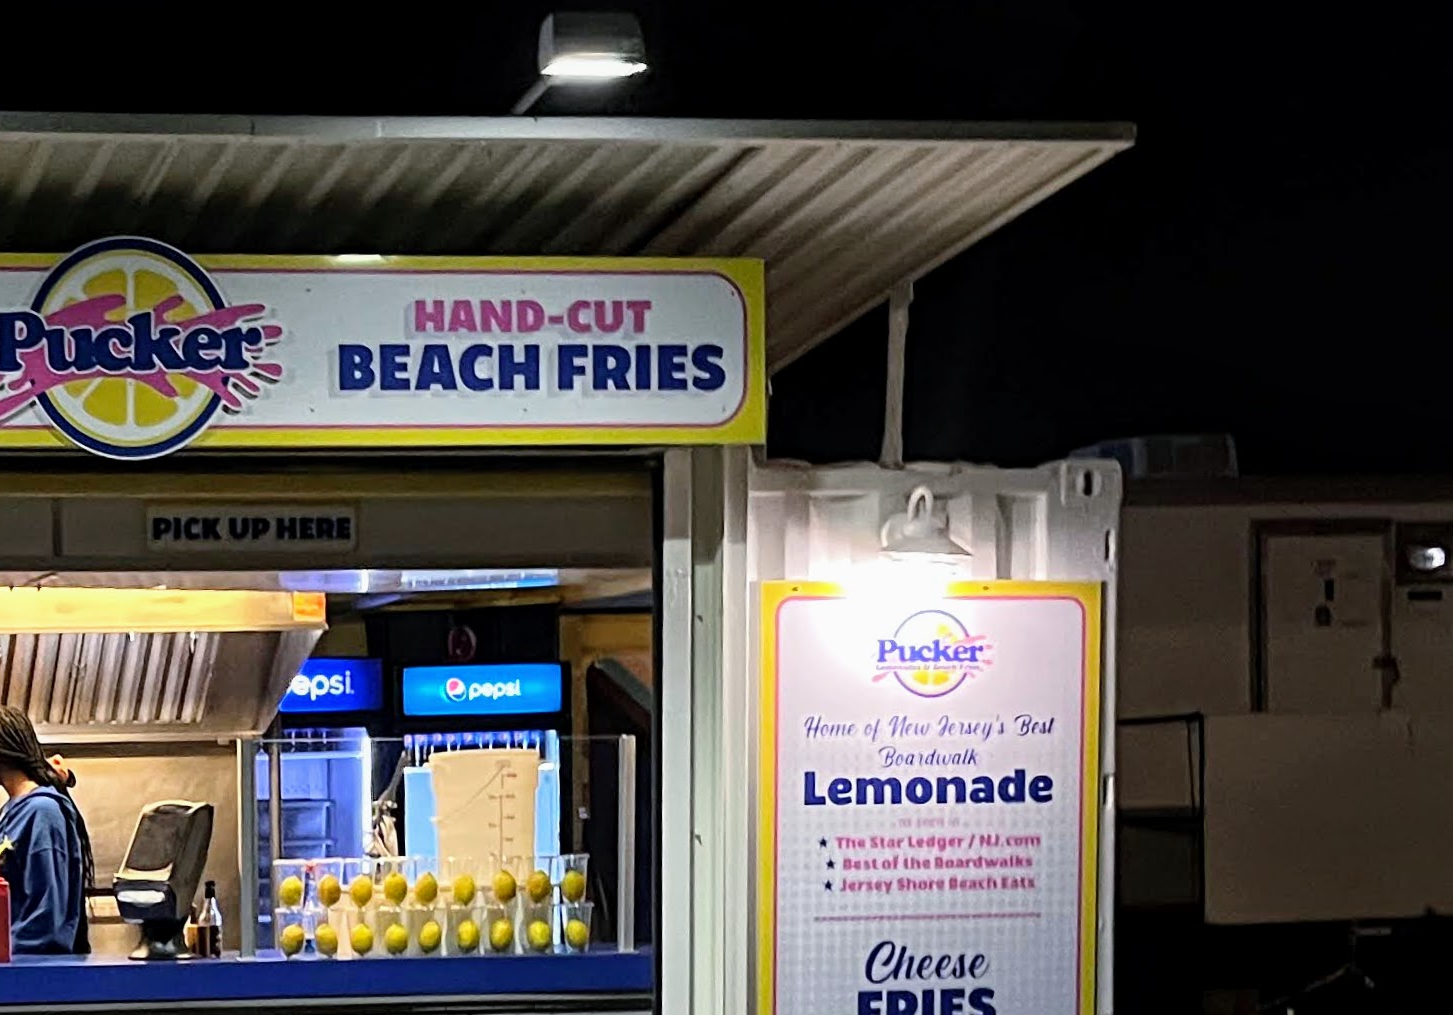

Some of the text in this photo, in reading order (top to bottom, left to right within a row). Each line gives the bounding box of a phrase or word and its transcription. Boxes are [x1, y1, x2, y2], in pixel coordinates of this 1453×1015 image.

[414, 299, 652, 334] HAND-CUT
[337, 343, 726, 392] BEACH FRIES
[152, 515, 351, 542] PICK UP HERE
[877, 639, 984, 662] Pucker
[288, 670, 351, 701] epsi
[469, 679, 521, 700] pepsi
[803, 714, 1055, 742] Home of New Jersey's Best
[878, 746, 978, 768] Boardwalk
[803, 769, 1054, 806] Lemonade
[836, 836, 866, 849] The
[870, 835, 904, 849] Star
[908, 835, 963, 851] Ledger
[842, 855, 1033, 871] Best of the Boardwalks
[840, 876, 1035, 894] Jersey Shore Beach Eats
[864, 941, 989, 983] Cheese
